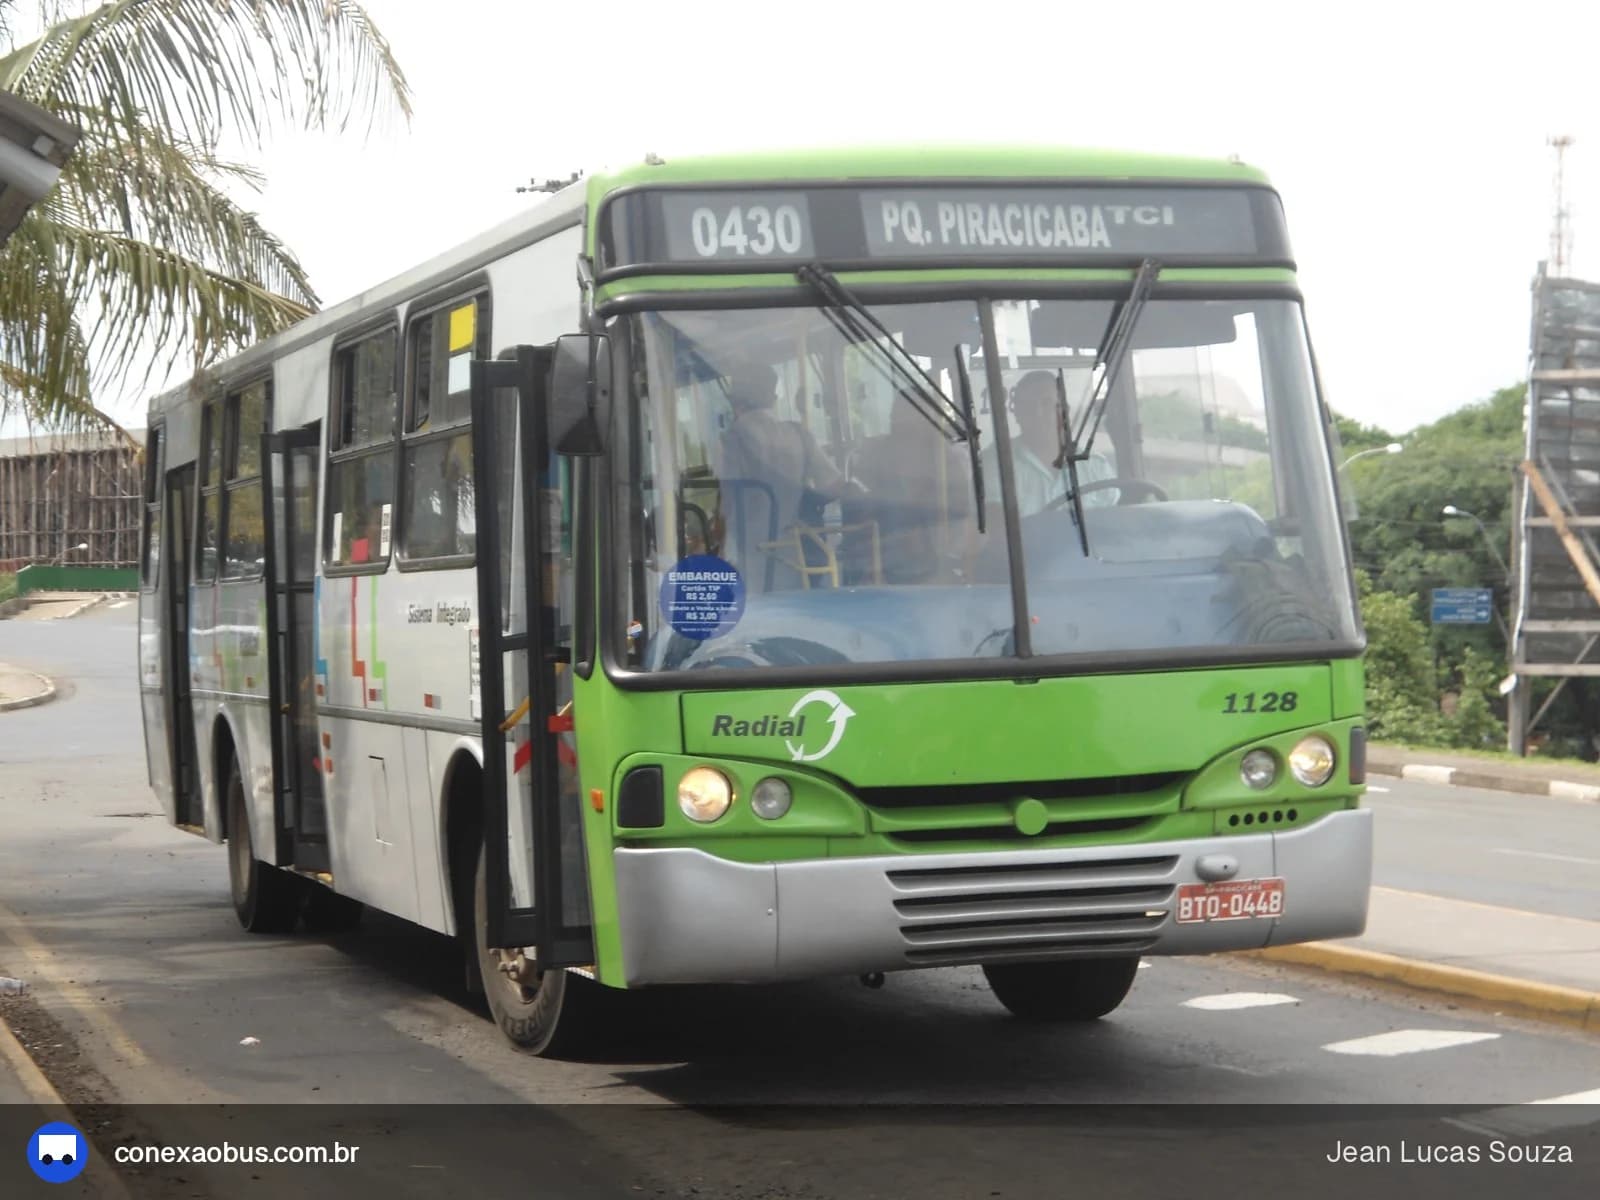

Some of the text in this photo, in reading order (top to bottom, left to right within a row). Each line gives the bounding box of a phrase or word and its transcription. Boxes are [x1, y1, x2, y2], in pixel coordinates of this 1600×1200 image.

[881, 200, 1112, 248] PQ. PIRACICABA
[1106, 205, 1174, 225] TCI
[692, 205, 801, 256] 0430
[668, 571, 737, 582] EMBARQUE
[408, 601, 471, 626] Sistema Integrado
[1221, 691, 1298, 714] 1128
[712, 715, 806, 737] Radial
[1180, 891, 1282, 919] BTO-0448
